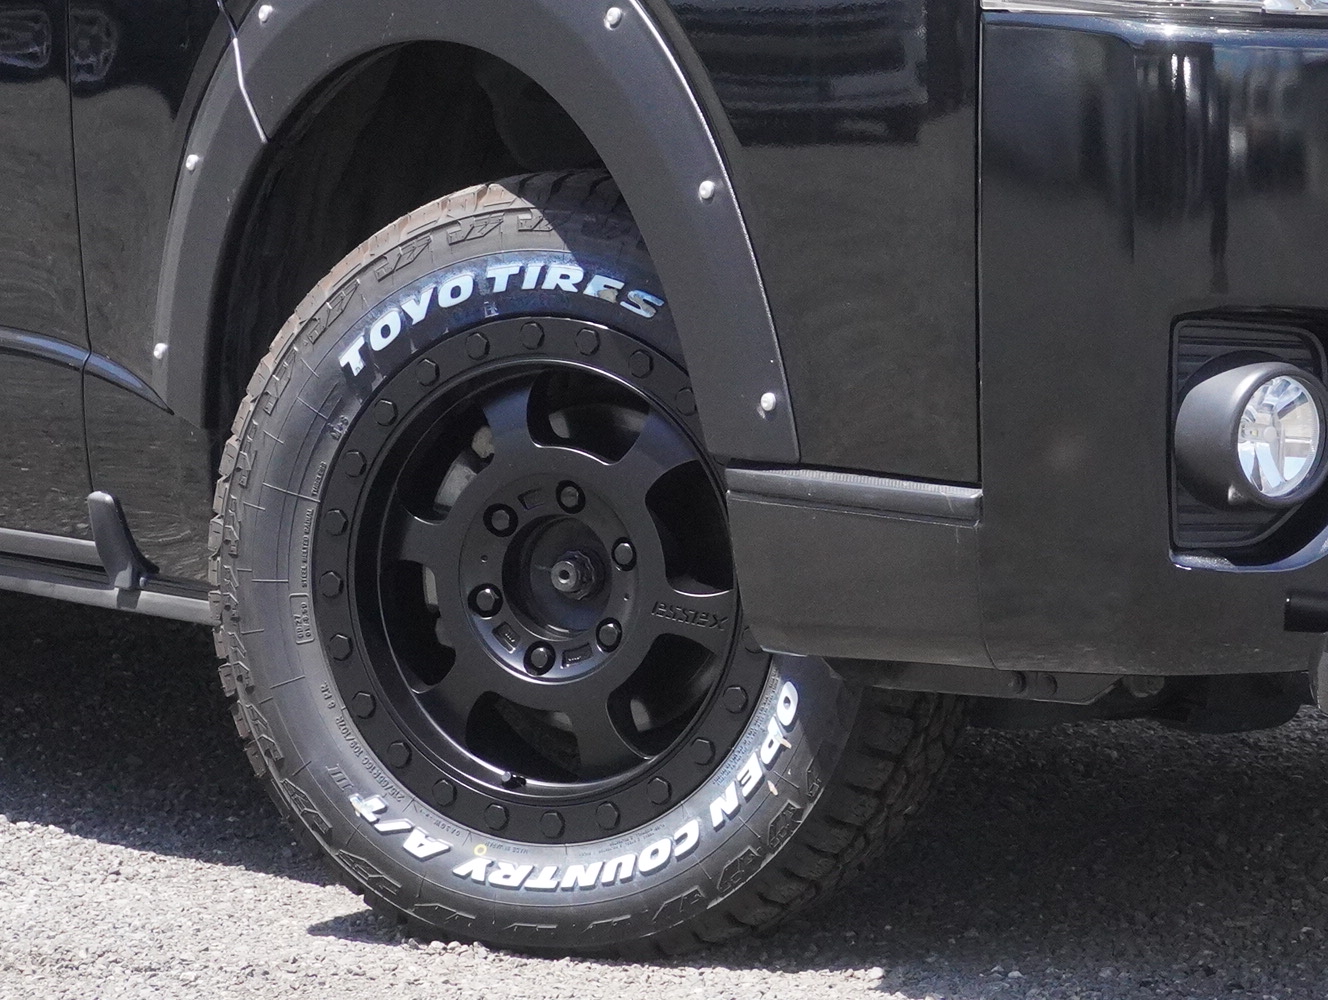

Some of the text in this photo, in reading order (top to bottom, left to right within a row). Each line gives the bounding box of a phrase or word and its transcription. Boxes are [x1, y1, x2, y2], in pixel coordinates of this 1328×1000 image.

[339, 264, 665, 377] TOYO TIRES
[709, 681, 799, 829] OPEN
[348, 793, 451, 861] A/T
[452, 819, 699, 891] COUNTRY
